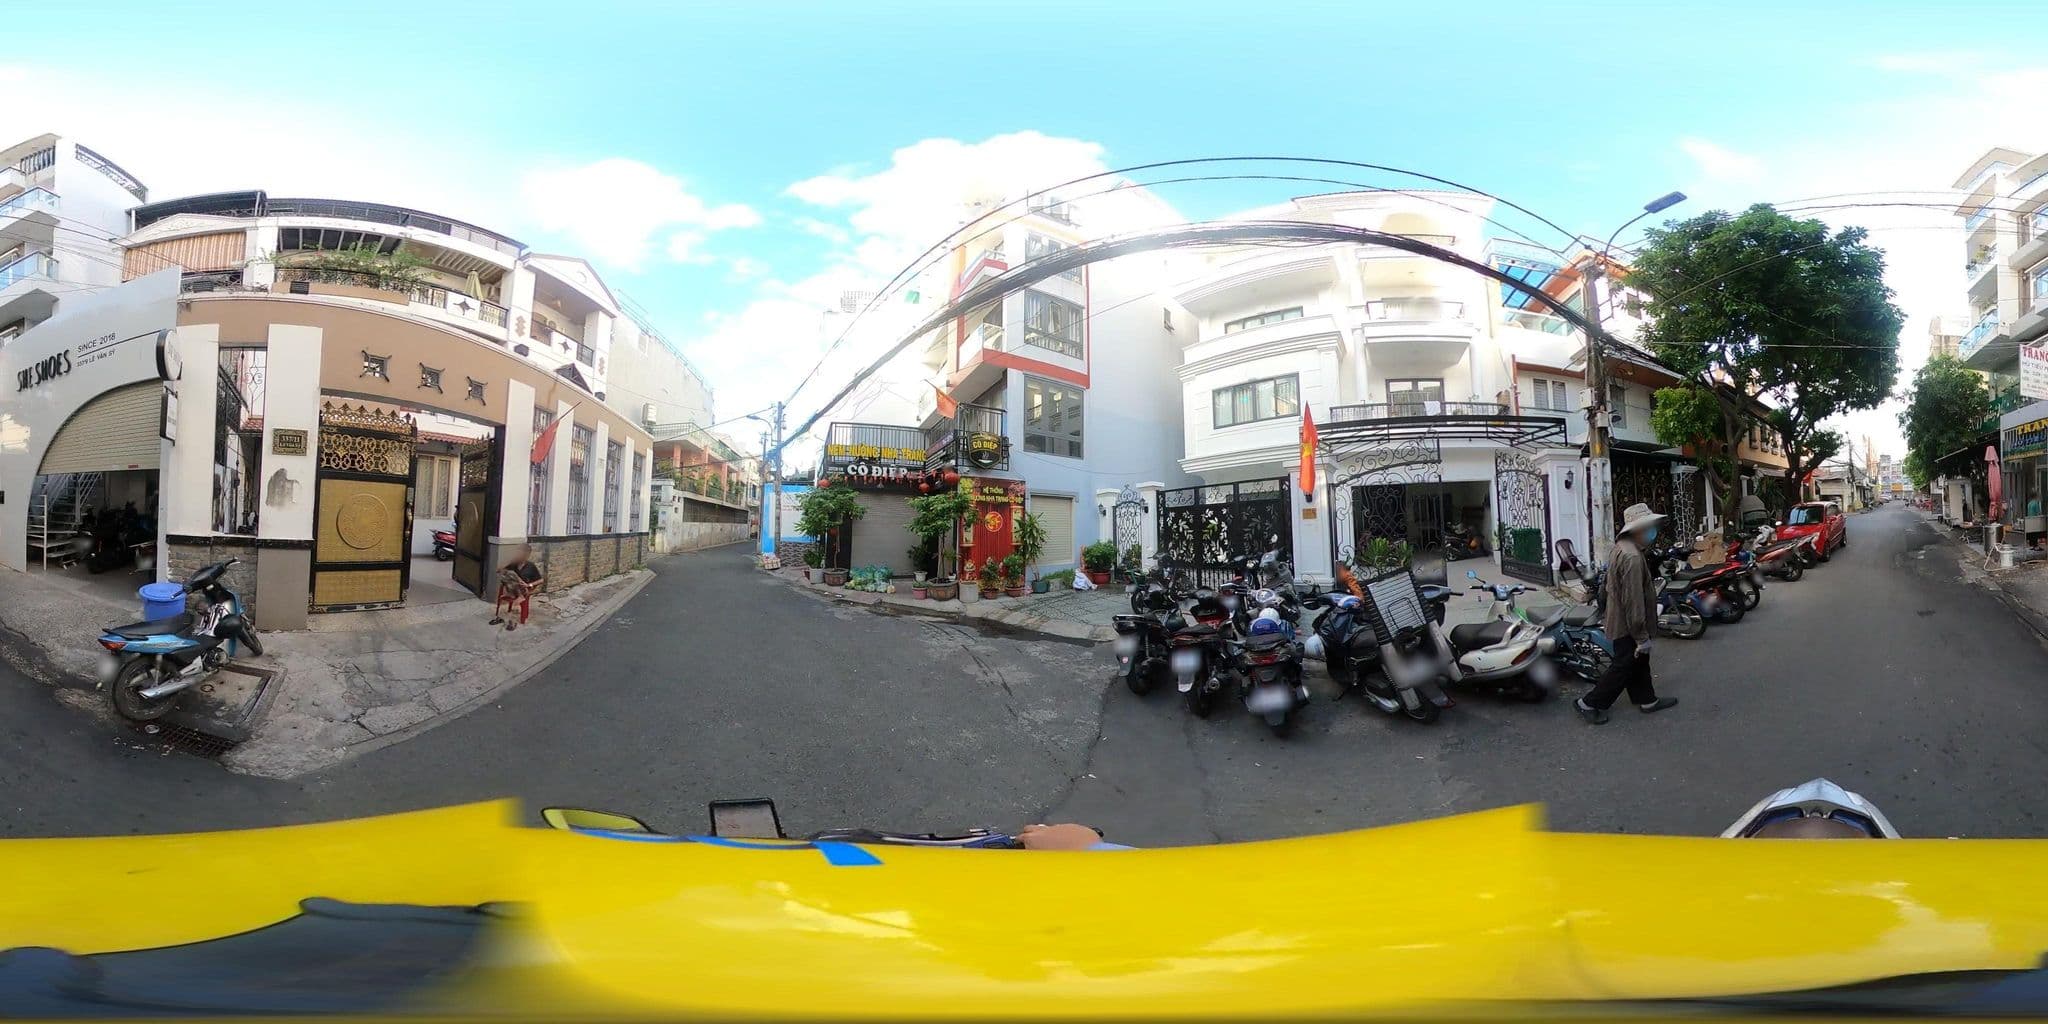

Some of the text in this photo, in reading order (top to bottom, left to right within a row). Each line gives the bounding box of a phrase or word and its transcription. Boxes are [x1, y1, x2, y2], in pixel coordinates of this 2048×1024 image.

[77, 339, 97, 352] SINCE
[34, 349, 71, 385] SHOES
[901, 447, 927, 462] TRANG
[847, 461, 869, 476] CÔ
